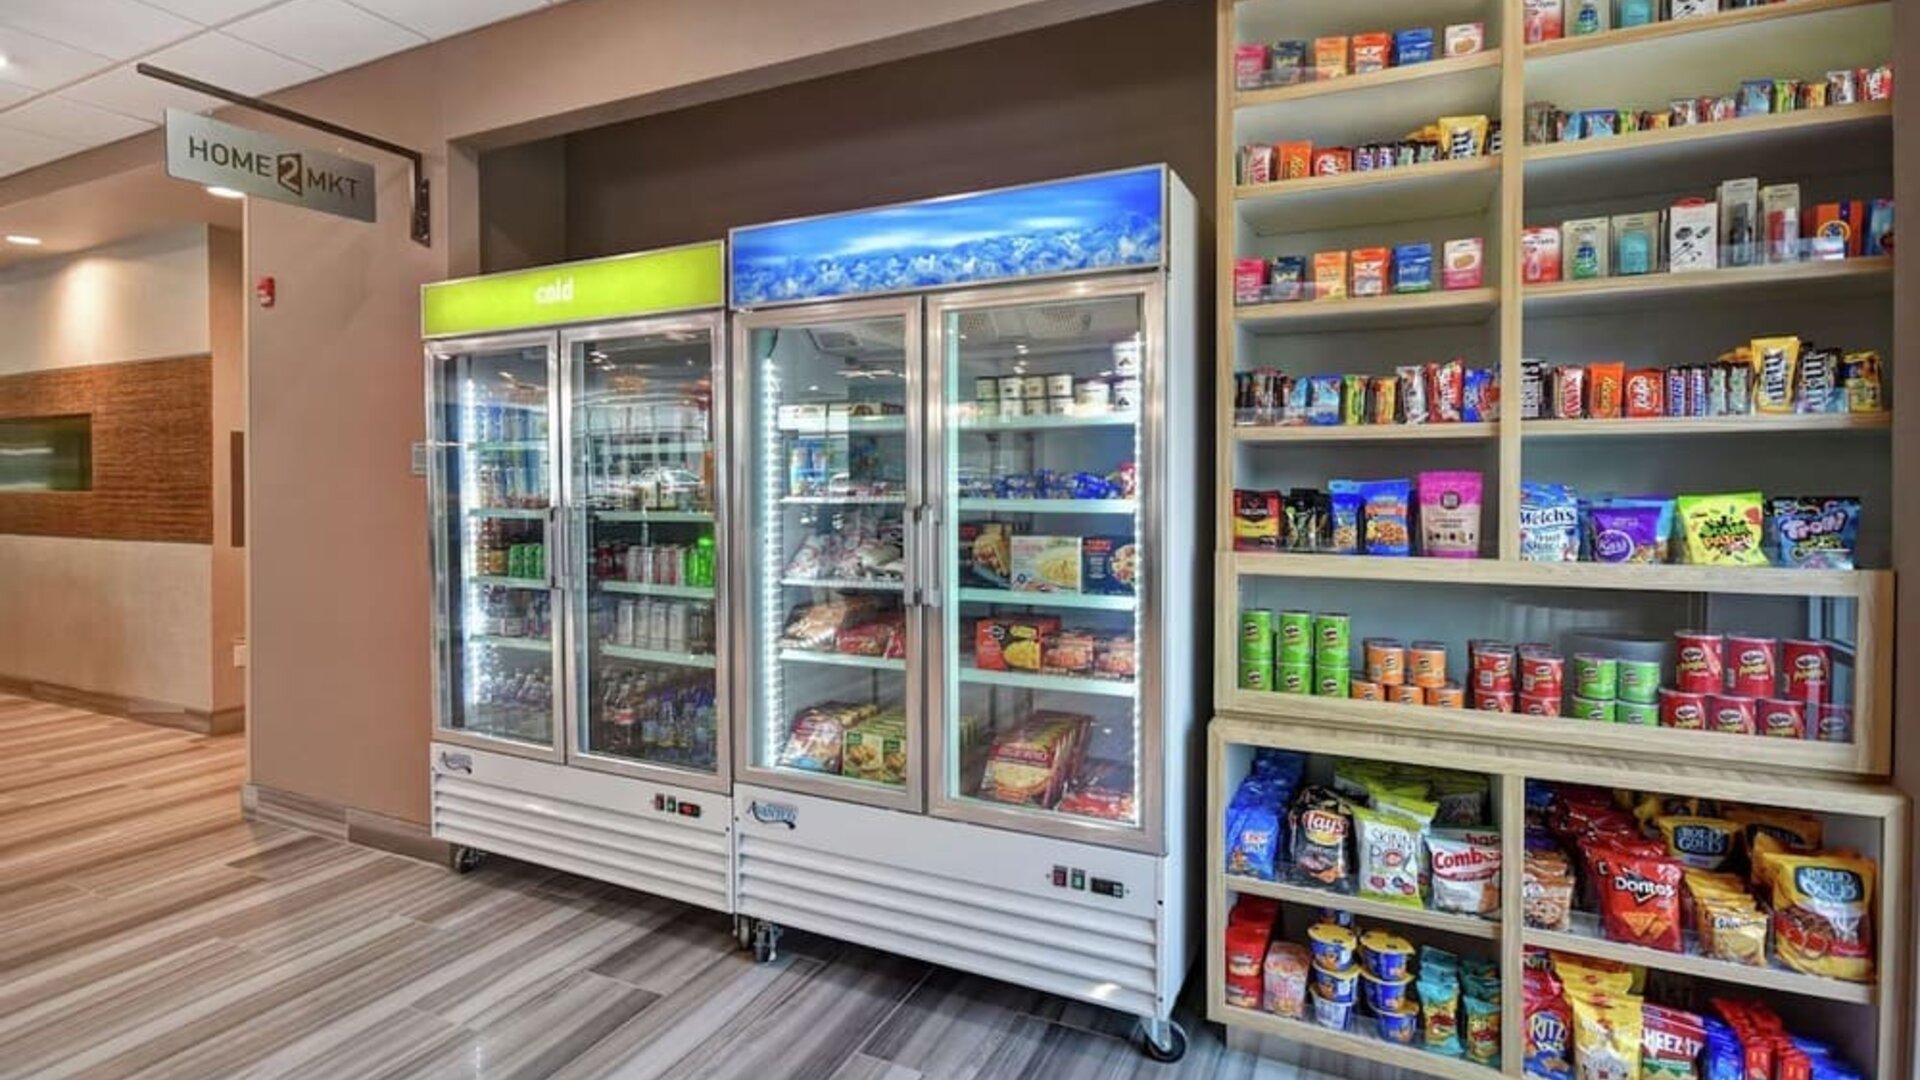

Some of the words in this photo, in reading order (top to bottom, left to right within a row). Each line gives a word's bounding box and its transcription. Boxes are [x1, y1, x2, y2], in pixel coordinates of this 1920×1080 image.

[188, 136, 272, 178] HOME
[306, 167, 362, 199] MKT
[533, 277, 575, 305] cold
